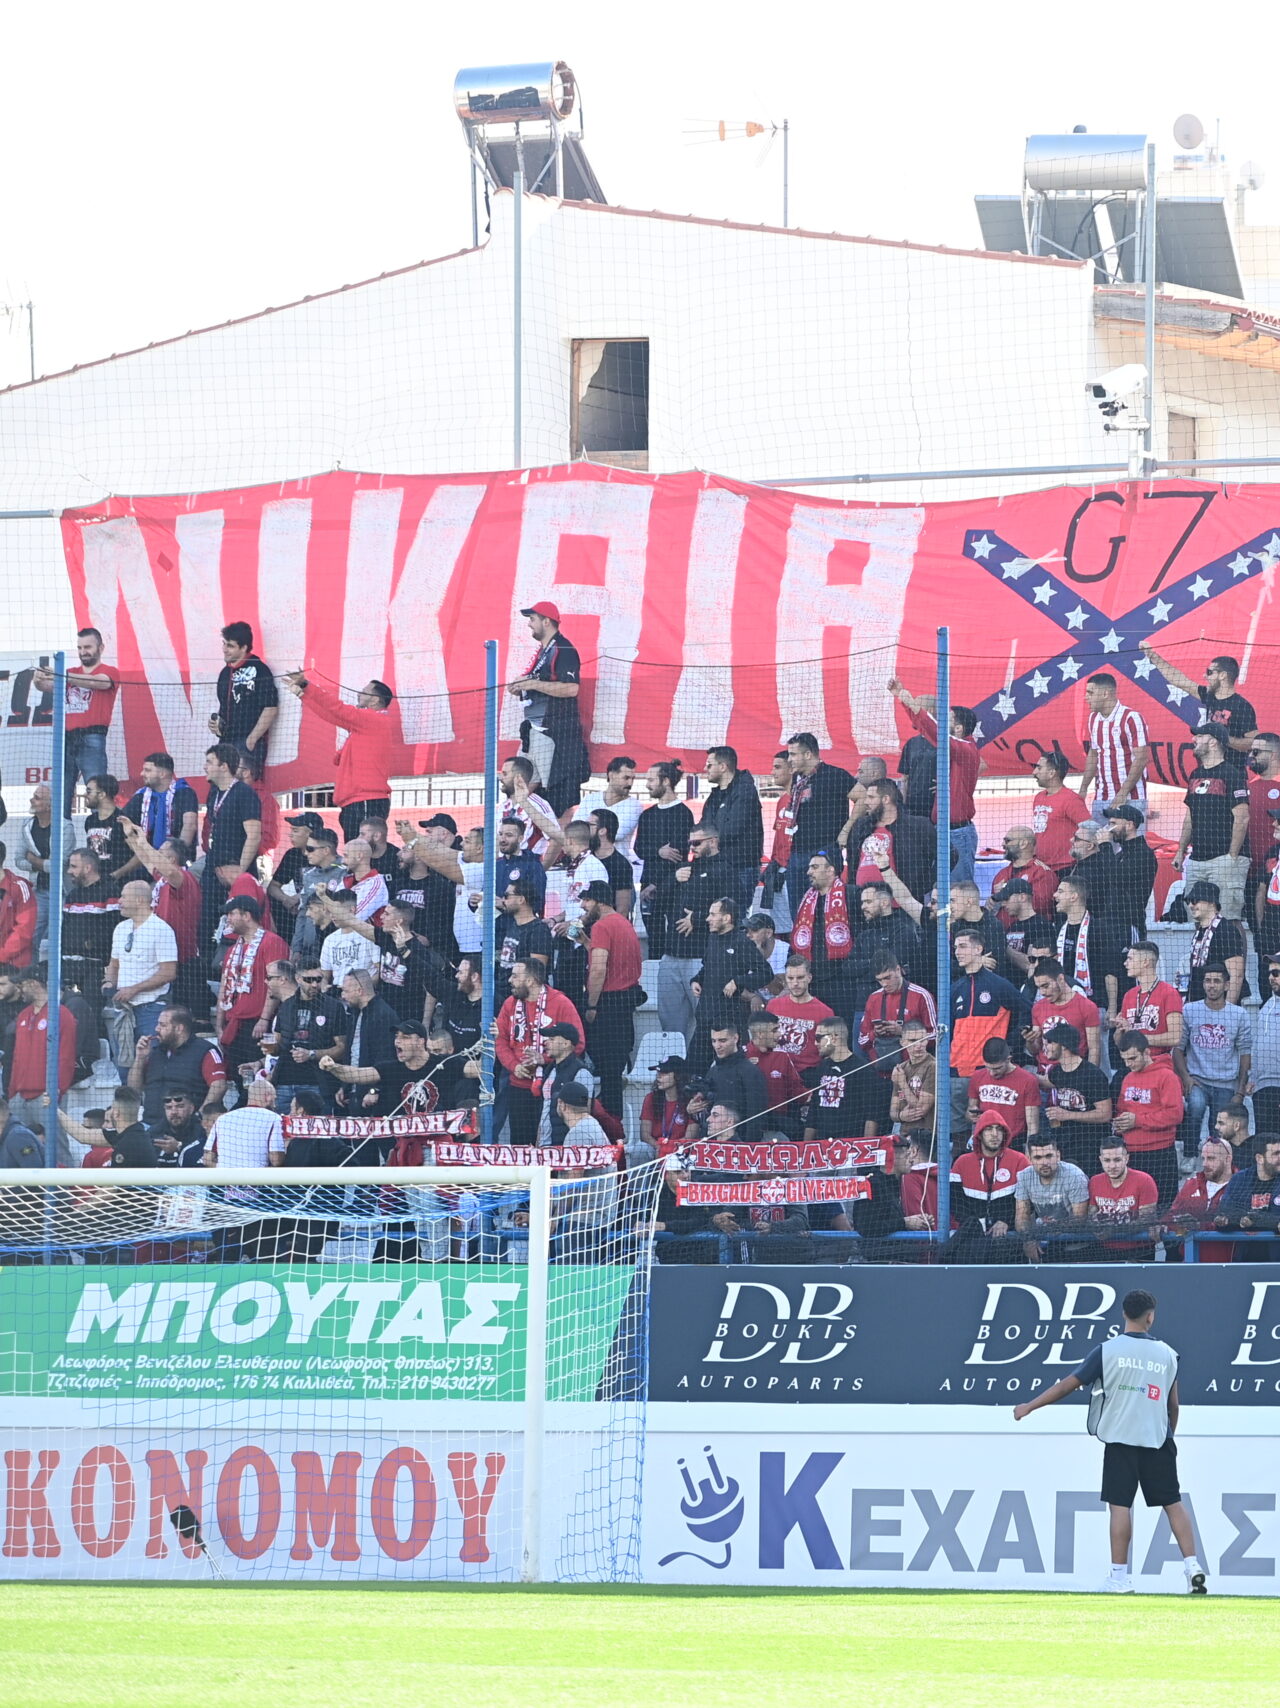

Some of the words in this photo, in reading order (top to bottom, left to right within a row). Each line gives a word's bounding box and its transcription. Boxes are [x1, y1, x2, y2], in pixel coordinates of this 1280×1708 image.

[65, 1282, 522, 1345] ΜΠΟΥΤΑΣ
[715, 1323, 857, 1339] BOUKIS
[976, 1324, 1121, 1340] BOUKIS
[1117, 1357, 1144, 1370] BALL
[1146, 1361, 1168, 1376] BOY
[233, 1374, 259, 1390] 176
[262, 1375, 280, 1390] 74
[677, 1375, 864, 1391] AUTOPARTS
